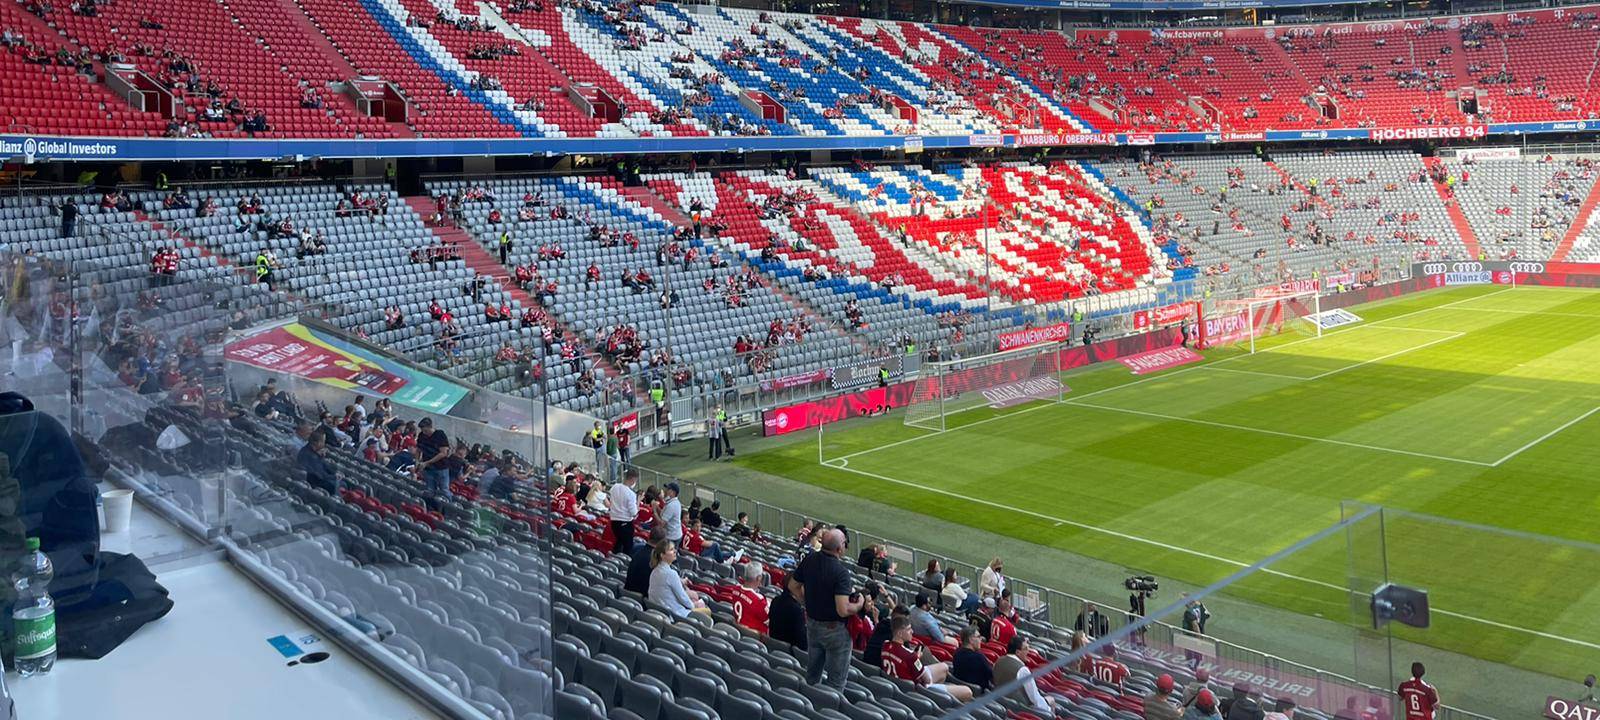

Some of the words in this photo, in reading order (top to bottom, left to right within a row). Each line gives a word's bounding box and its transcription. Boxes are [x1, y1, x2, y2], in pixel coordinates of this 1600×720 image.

[38, 141, 67, 154] Global
[69, 142, 117, 155] Investors
[1023, 135, 1060, 145] NABBURG
[1066, 133, 1107, 144] OBERPFALZ
[1446, 274, 1478, 283] Allianz
[1206, 314, 1246, 337] BAYERN
[1000, 325, 1067, 349] SCHWANENKIRCHEN
[735, 601, 742, 623] 9
[1098, 665, 1113, 684] 10
[1411, 694, 1420, 711] 6
